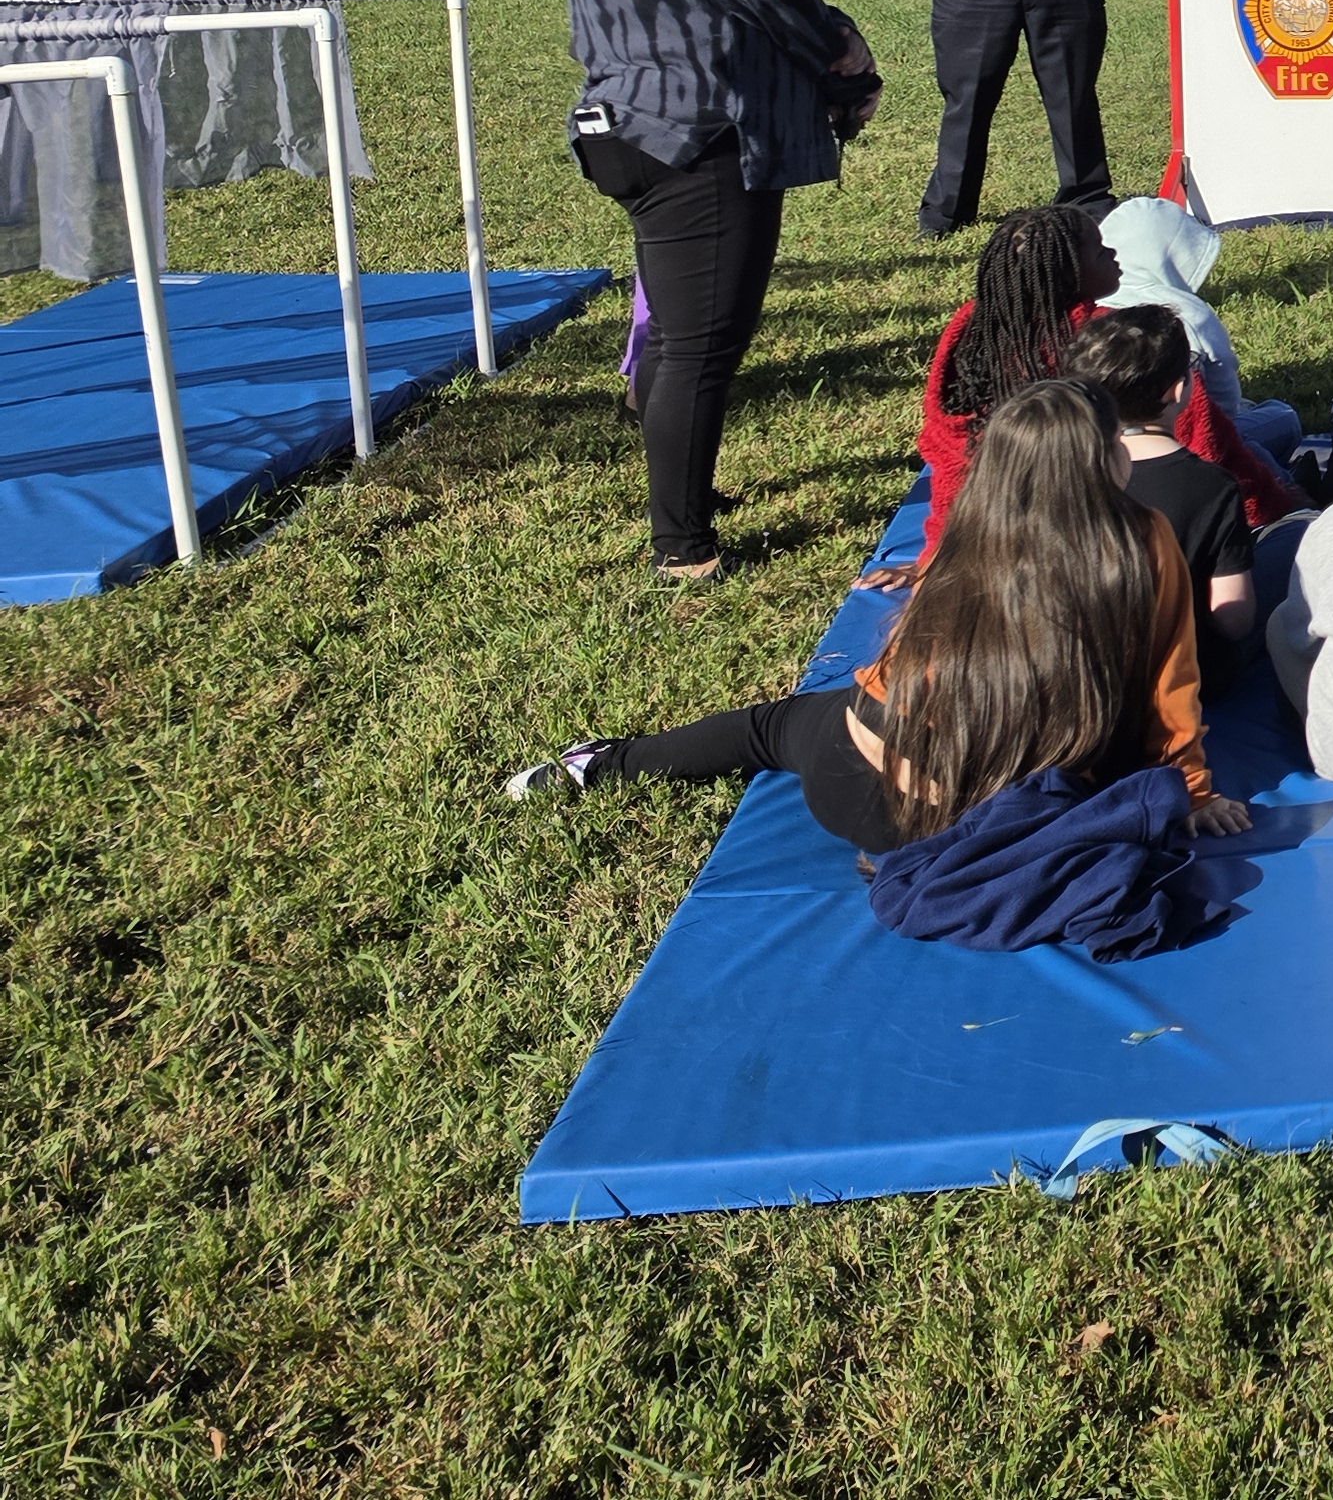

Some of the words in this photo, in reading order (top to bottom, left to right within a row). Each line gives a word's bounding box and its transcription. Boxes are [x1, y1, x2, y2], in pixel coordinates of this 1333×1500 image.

[1260, 5, 1271, 24] CITY
[1291, 38, 1311, 47] 1963
[1276, 65, 1330, 91] Fire
